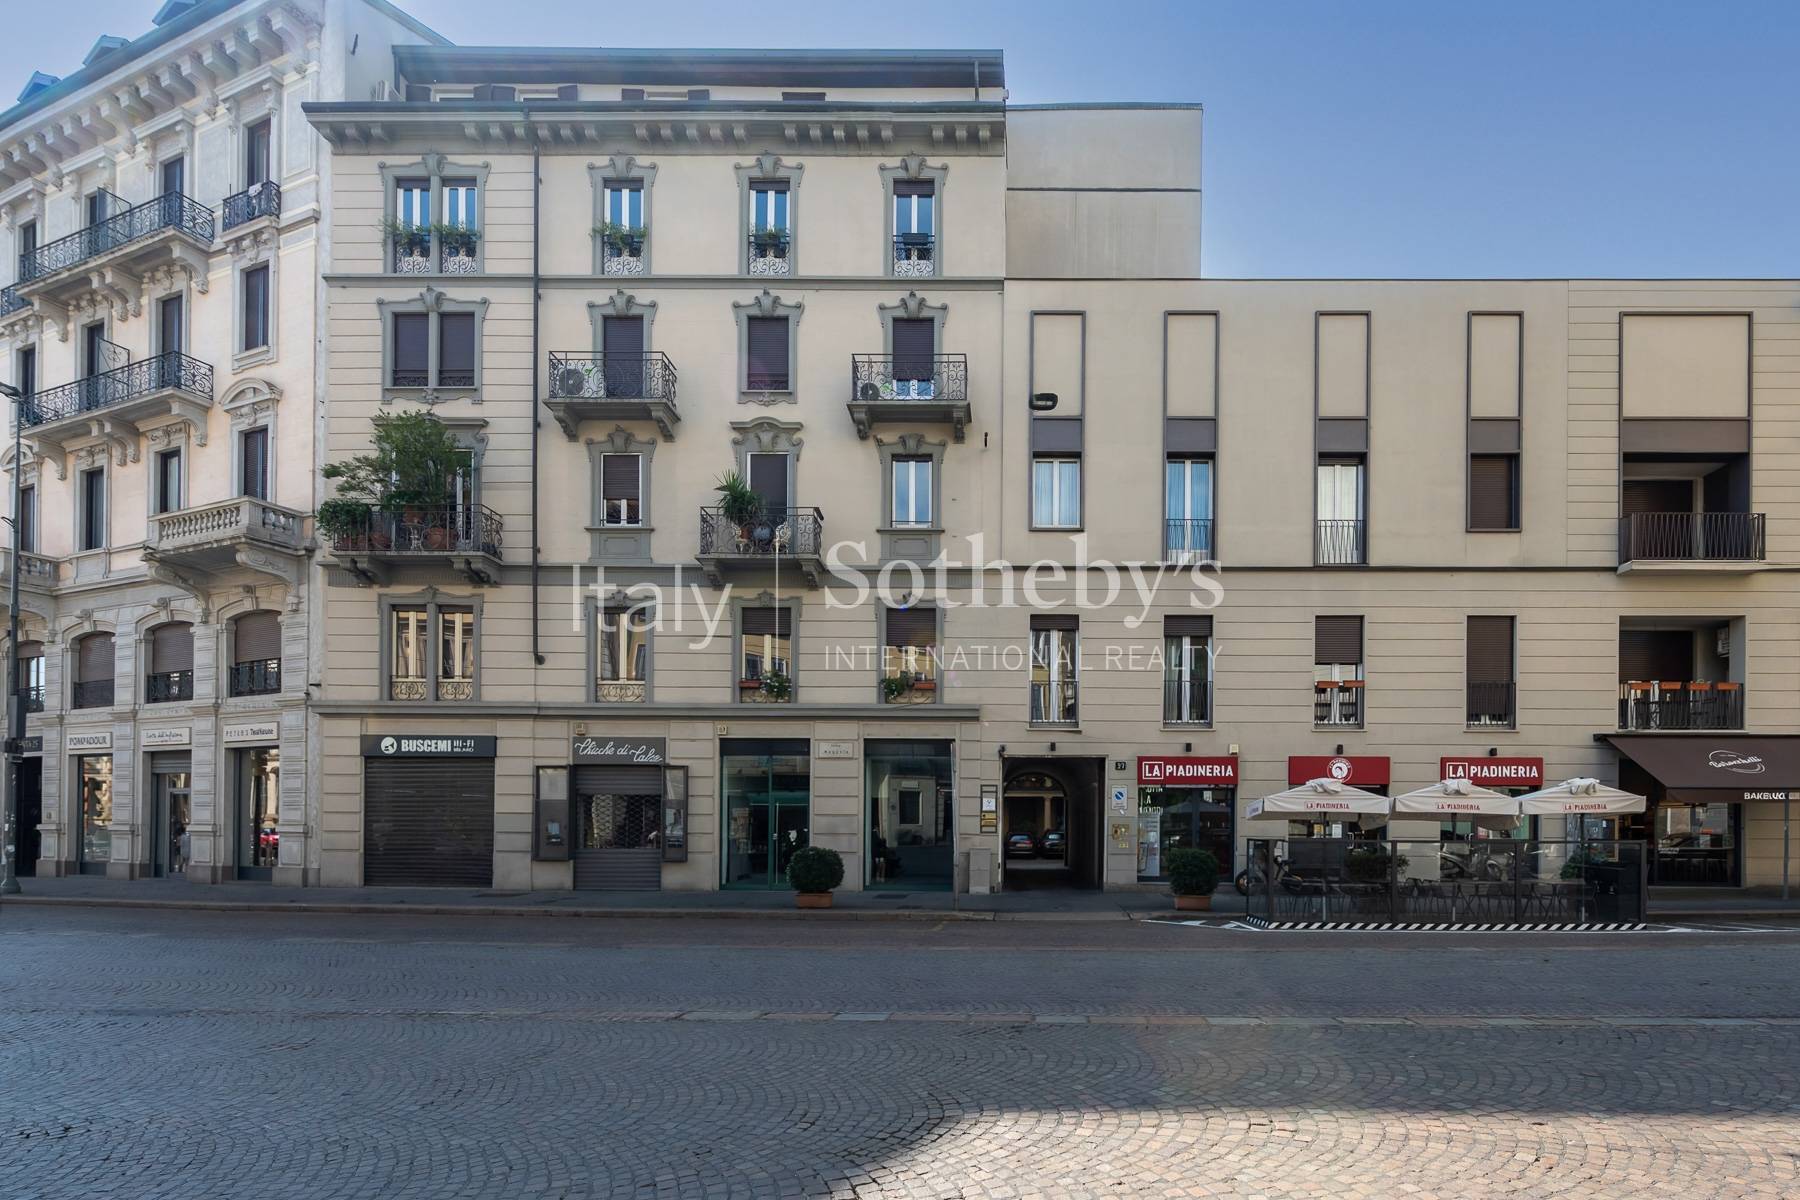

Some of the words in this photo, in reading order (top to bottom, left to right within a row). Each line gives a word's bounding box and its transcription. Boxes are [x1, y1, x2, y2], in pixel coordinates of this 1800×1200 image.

[401, 739, 451, 752] BUSCEMI
[617, 744, 631, 755] di
[1145, 765, 1161, 777] LA
[1165, 765, 1234, 777] PIADINERIA
[1449, 765, 1465, 777] LA
[1470, 765, 1539, 778] PIADINERIA
